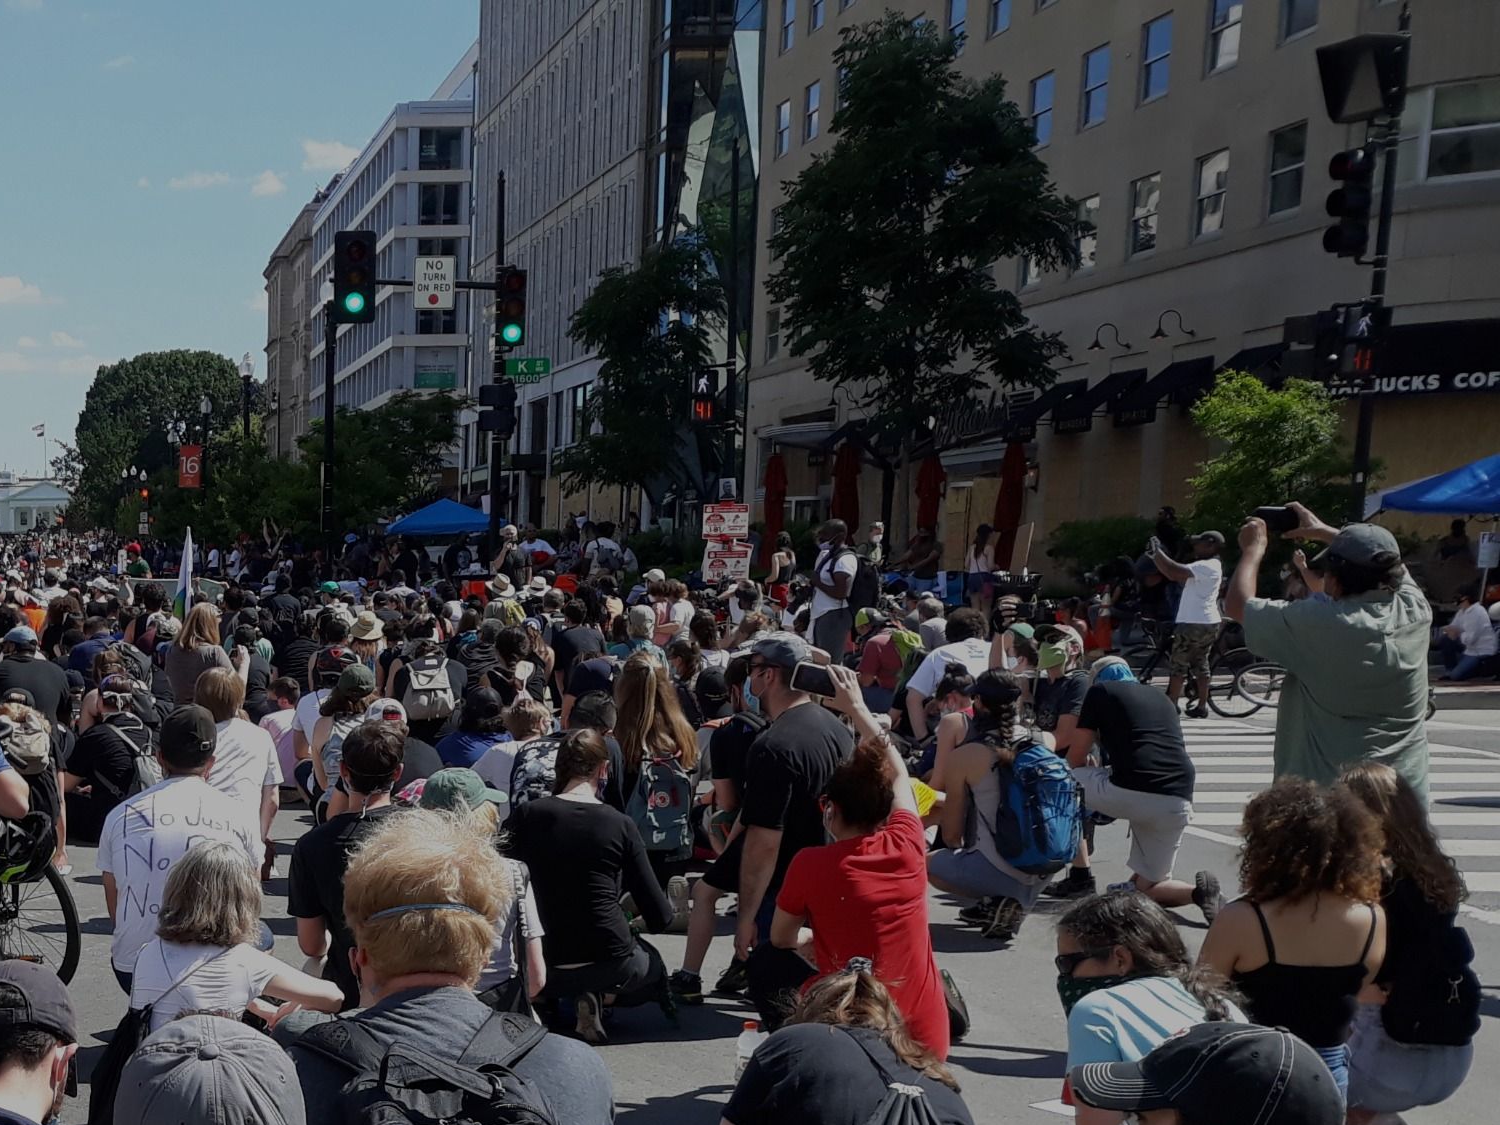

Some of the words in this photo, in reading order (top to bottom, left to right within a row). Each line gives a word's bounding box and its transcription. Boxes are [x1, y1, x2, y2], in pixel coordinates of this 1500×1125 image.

[425, 260, 444, 271] NO
[423, 272, 447, 281] TURN
[417, 283, 430, 292] ON
[433, 283, 451, 292] RED
[518, 361, 529, 373] K
[696, 401, 712, 419] 41
[180, 456, 199, 474] 16
[123, 795, 175, 838] No
[124, 838, 170, 877] No
[124, 883, 160, 922] No
